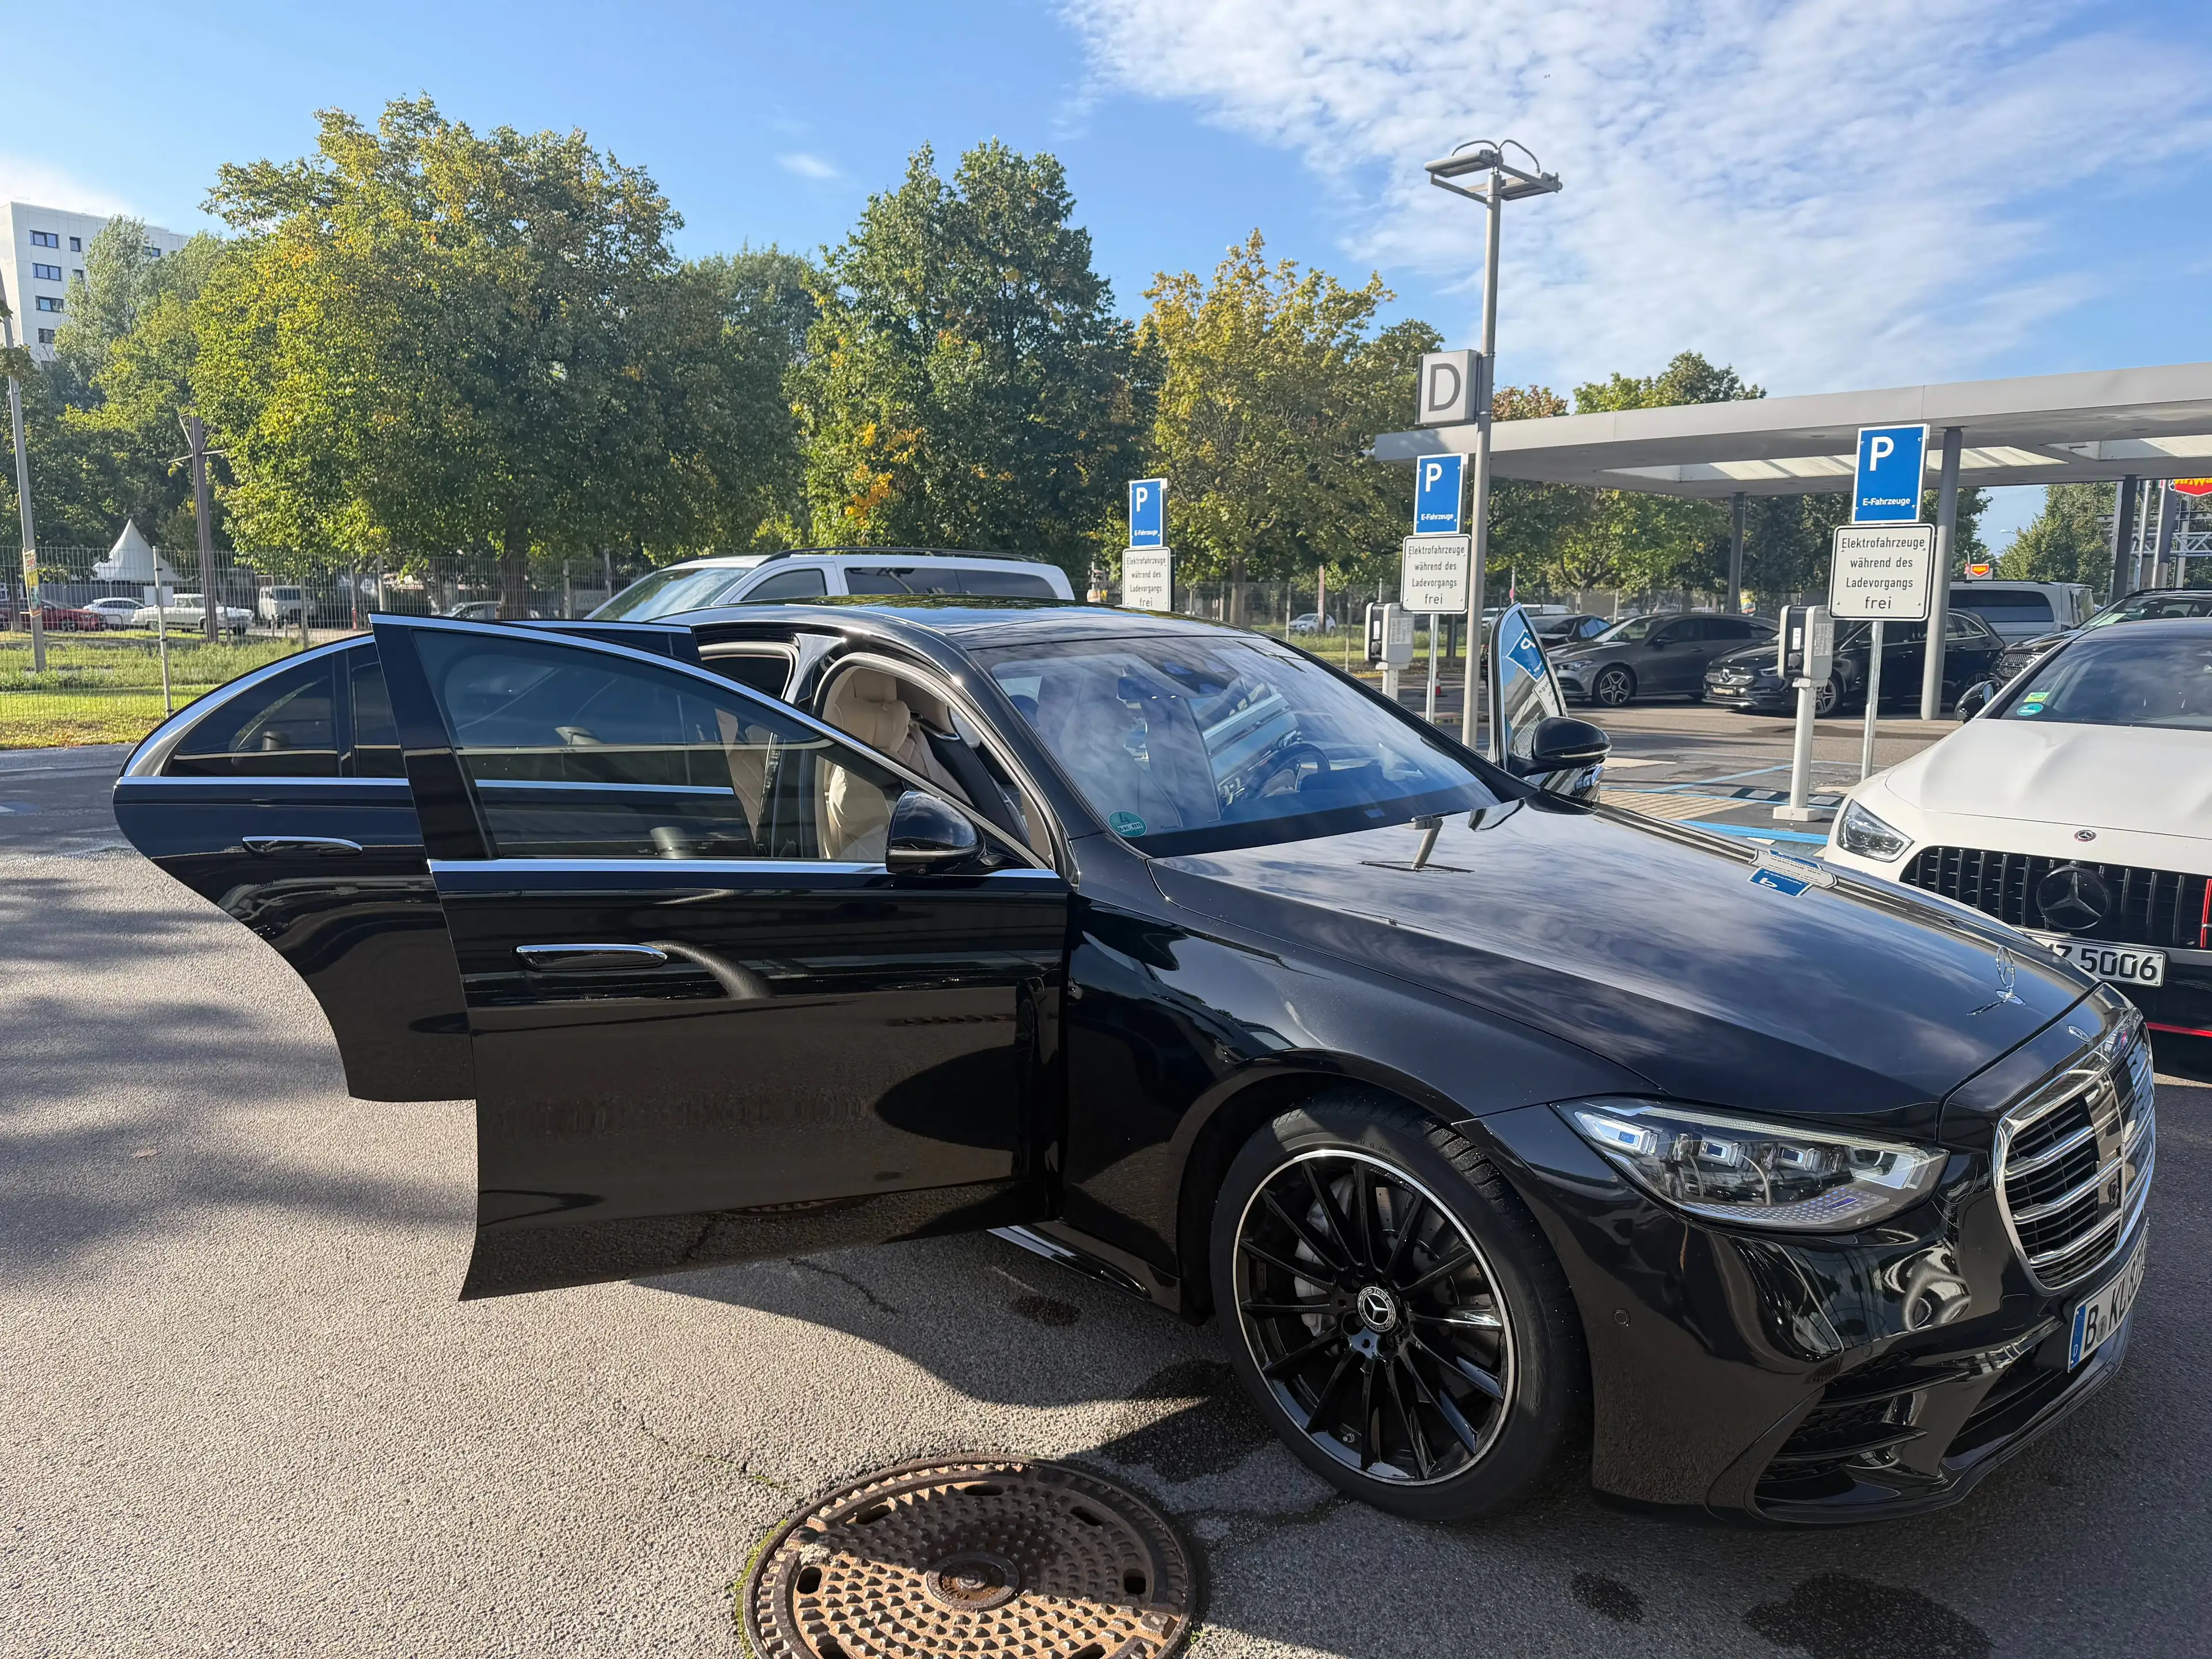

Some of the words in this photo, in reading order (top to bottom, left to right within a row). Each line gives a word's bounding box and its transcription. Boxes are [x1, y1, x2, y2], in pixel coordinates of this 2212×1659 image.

[1428, 363, 1461, 412] D
[1869, 436, 1894, 471] P
[1425, 463, 1442, 492] P
[1136, 487, 1148, 512] P
[1862, 497, 1910, 506] E-Fahrzeuge
[1842, 537, 1925, 550] Elektrofahrzeuge
[1408, 546, 1465, 555] Elektrofahrzeuge
[1127, 557, 1166, 566] Elektrofahrzeuge
[1415, 562, 1442, 571] während
[1445, 562, 1457, 570] des
[1850, 557, 1891, 568] während
[1896, 557, 1913, 567] des
[1131, 570, 1151, 578] während
[1153, 570, 1161, 578] des
[1411, 578, 1457, 589] Ladevorgangs
[1846, 577, 1913, 590] Ladevorgangs
[1130, 585, 1162, 594] Ladevorgangs
[1139, 597, 1153, 607] frei
[1425, 593, 1443, 604] frei
[1865, 596, 1892, 609] frei
[2048, 943, 2073, 959] Z
[2080, 948, 2157, 980] 5006
[2084, 1304, 2099, 1353] B
[2108, 1275, 2126, 1331] KL
